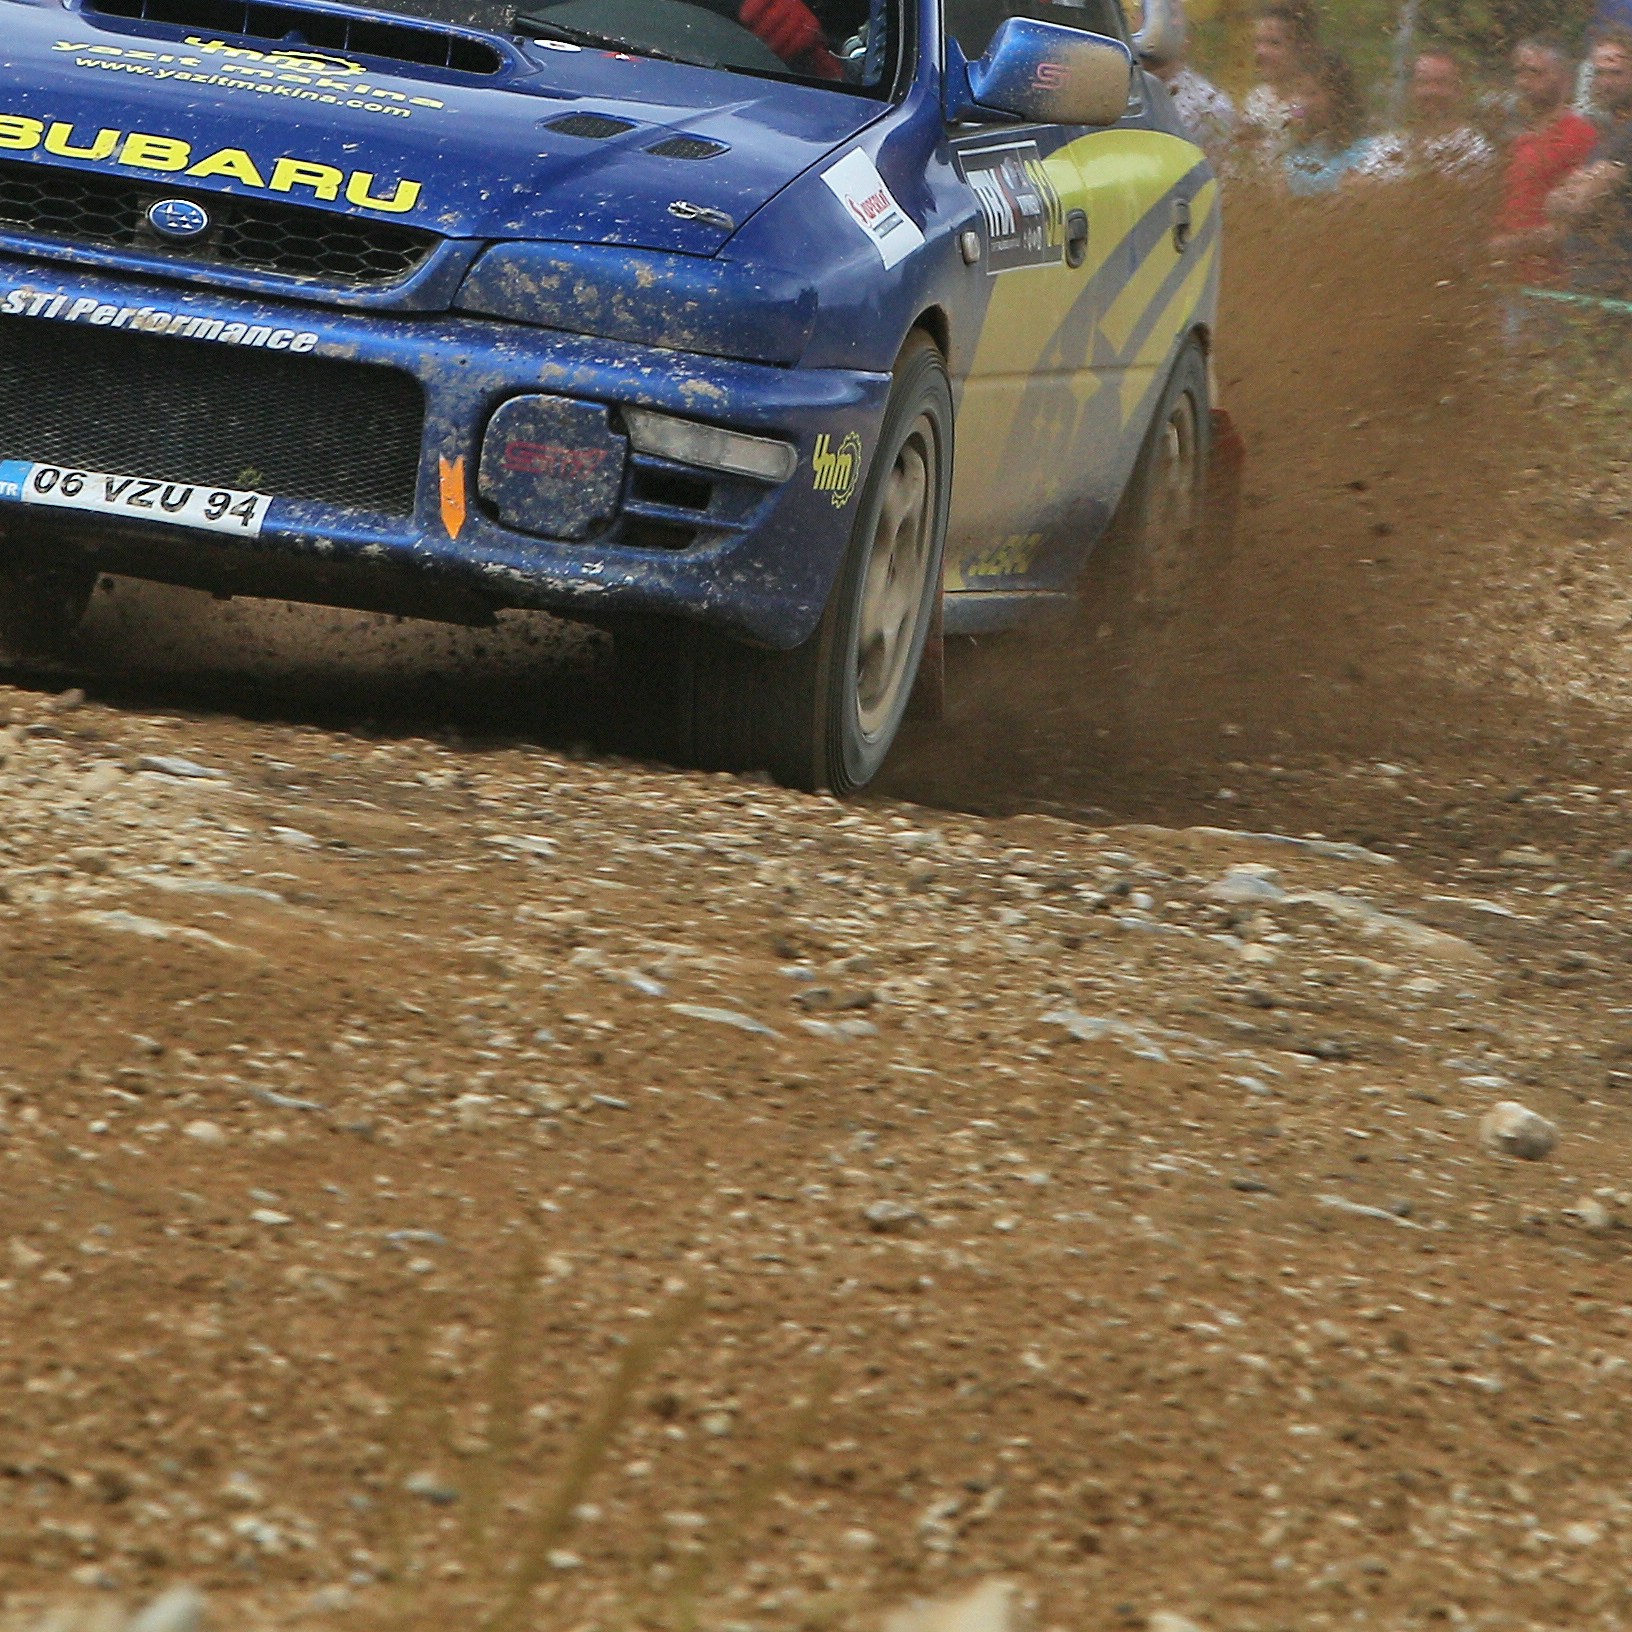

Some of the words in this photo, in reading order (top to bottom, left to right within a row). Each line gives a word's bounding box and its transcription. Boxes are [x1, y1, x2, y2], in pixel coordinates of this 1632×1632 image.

[220, 62, 445, 110] makina
[67, 297, 320, 354] Performance
[33, 468, 84, 497] 06
[103, 475, 192, 513] VZU
[204, 491, 258, 527] 94
